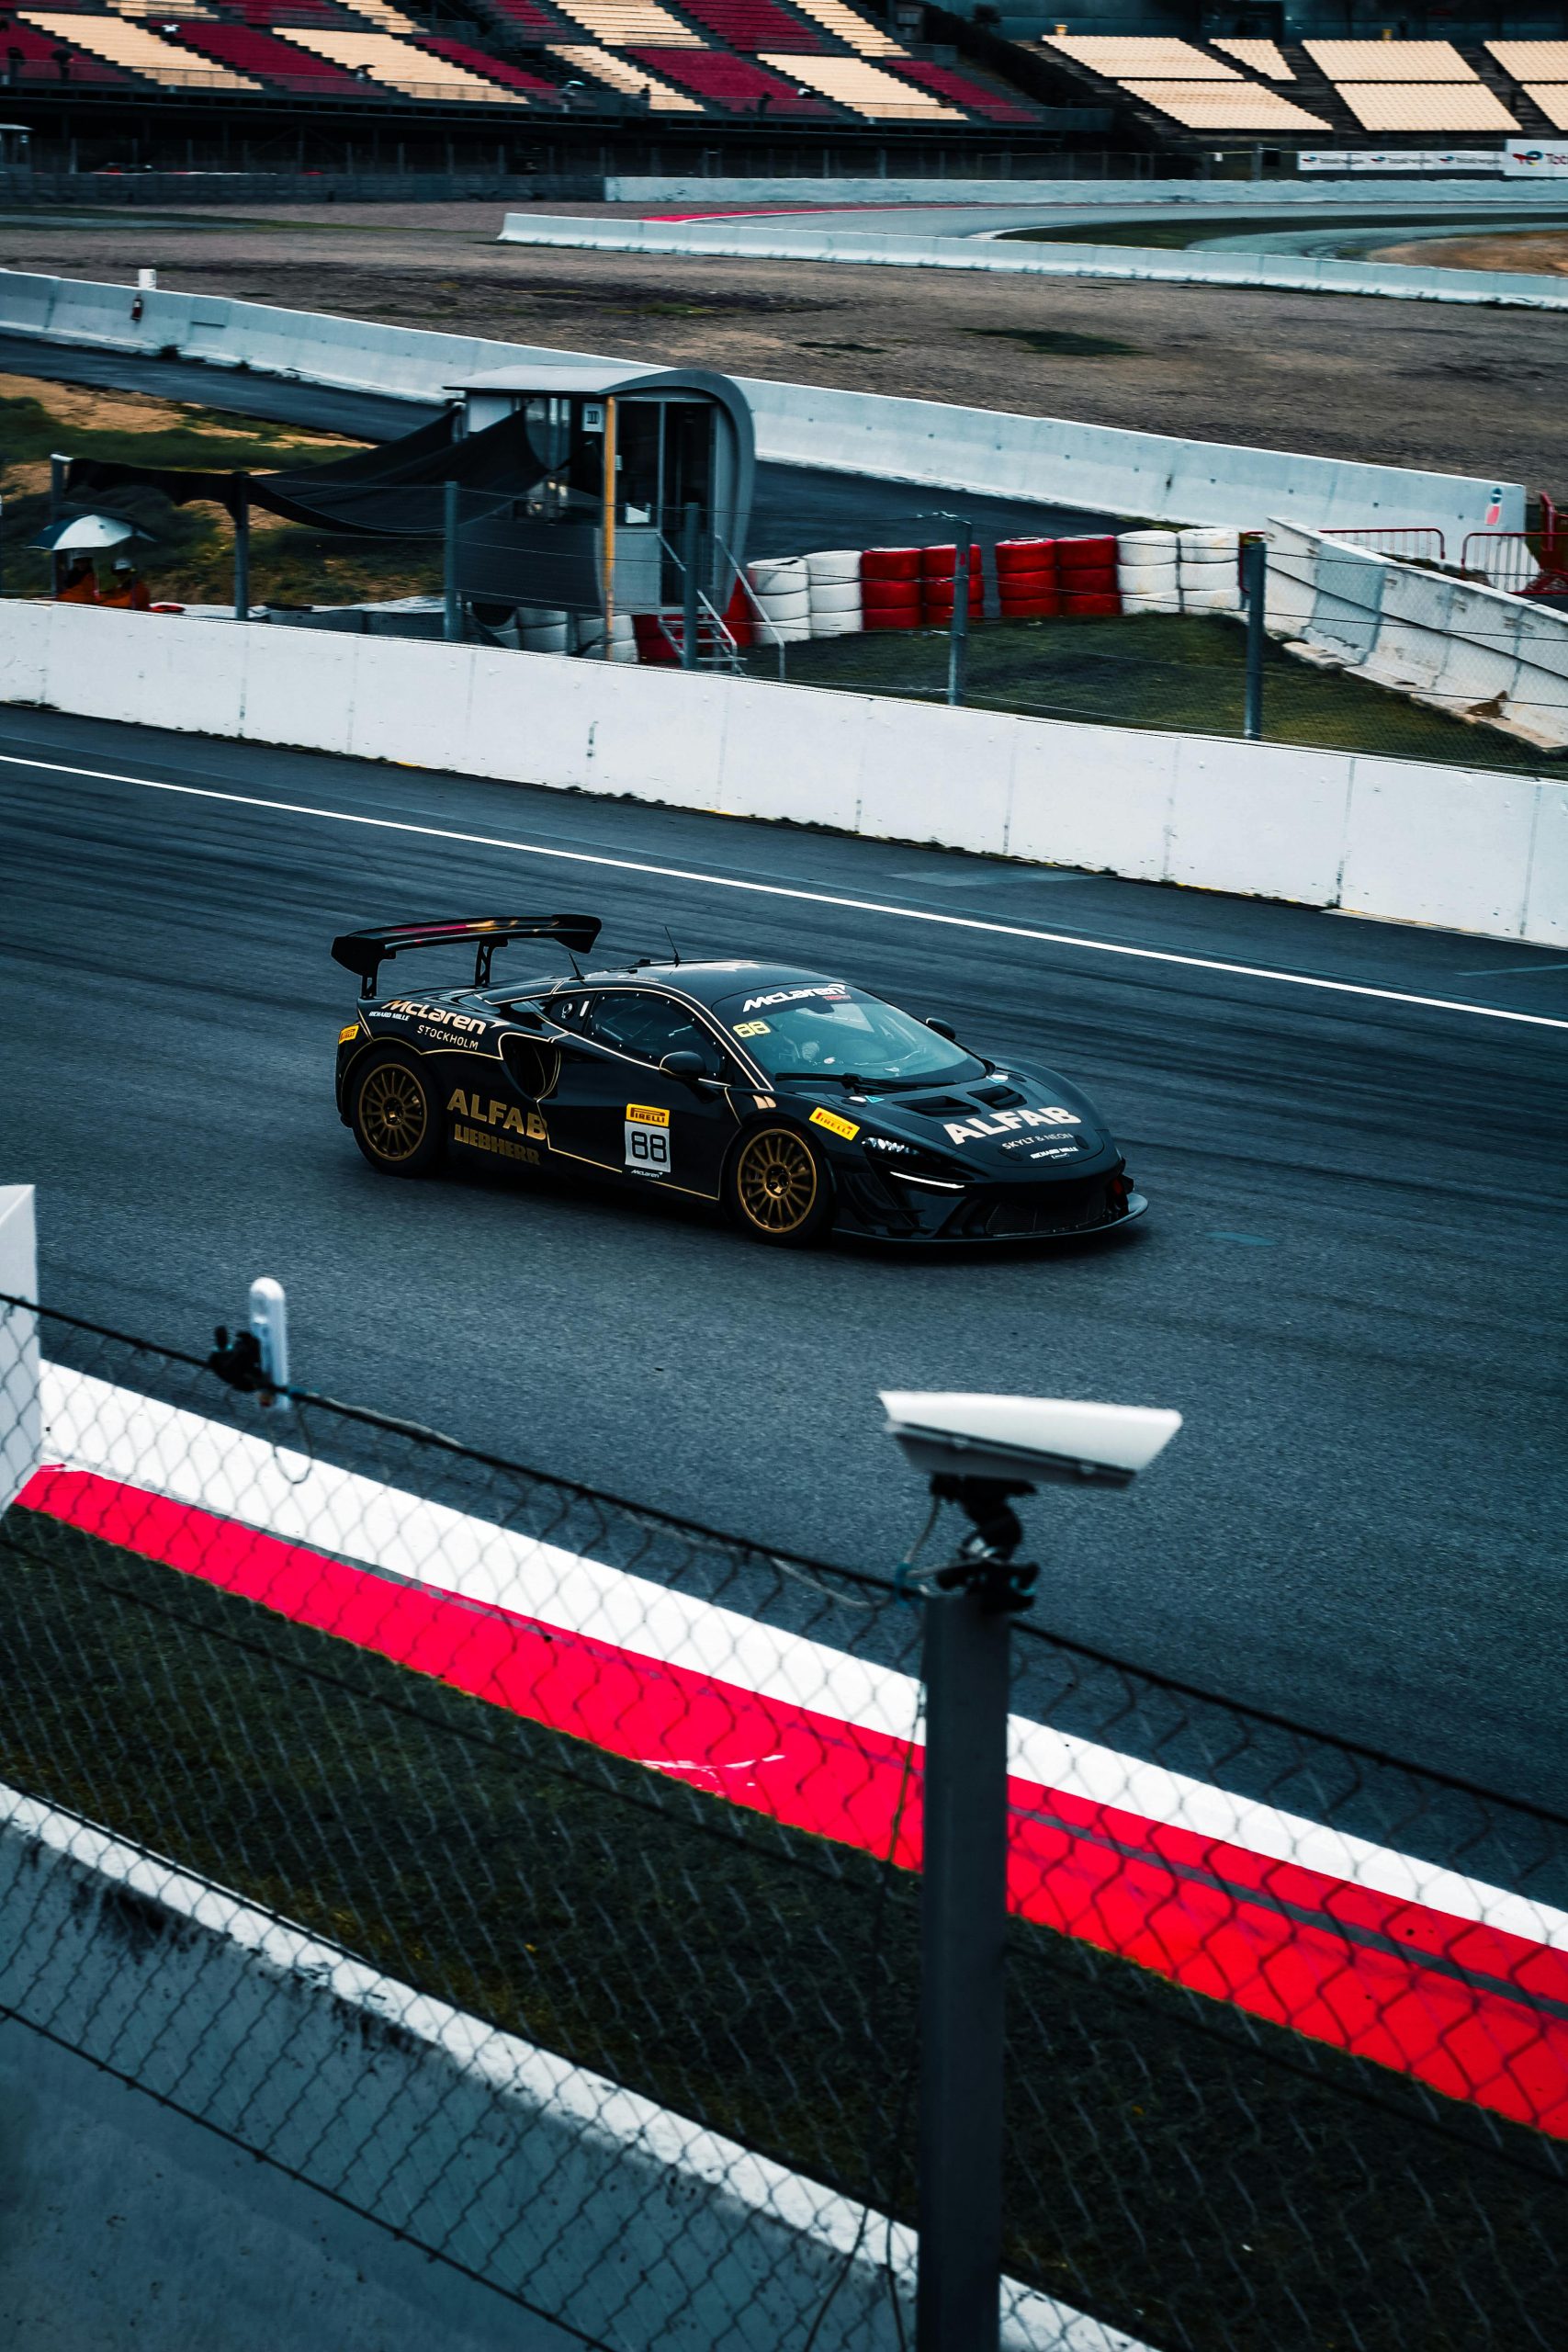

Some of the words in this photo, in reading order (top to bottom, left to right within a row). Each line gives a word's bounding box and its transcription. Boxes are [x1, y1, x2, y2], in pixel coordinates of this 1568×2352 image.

[741, 987, 845, 1012] McLaren
[381, 1000, 486, 1035] McLaren
[733, 1021, 771, 1038] 88
[417, 1024, 479, 1050] STOCKHOLM
[446, 1088, 547, 1141] ALFAB
[630, 1107, 665, 1123] PIRELLI
[816, 1112, 852, 1135] PIRELLI
[942, 1106, 1082, 1145] ALFAB
[454, 1124, 541, 1166] LIEBHERR
[631, 1130, 667, 1163] 88
[1001, 1136, 1035, 1149] SKYLT
[631, 1170, 660, 1179] McLaren
